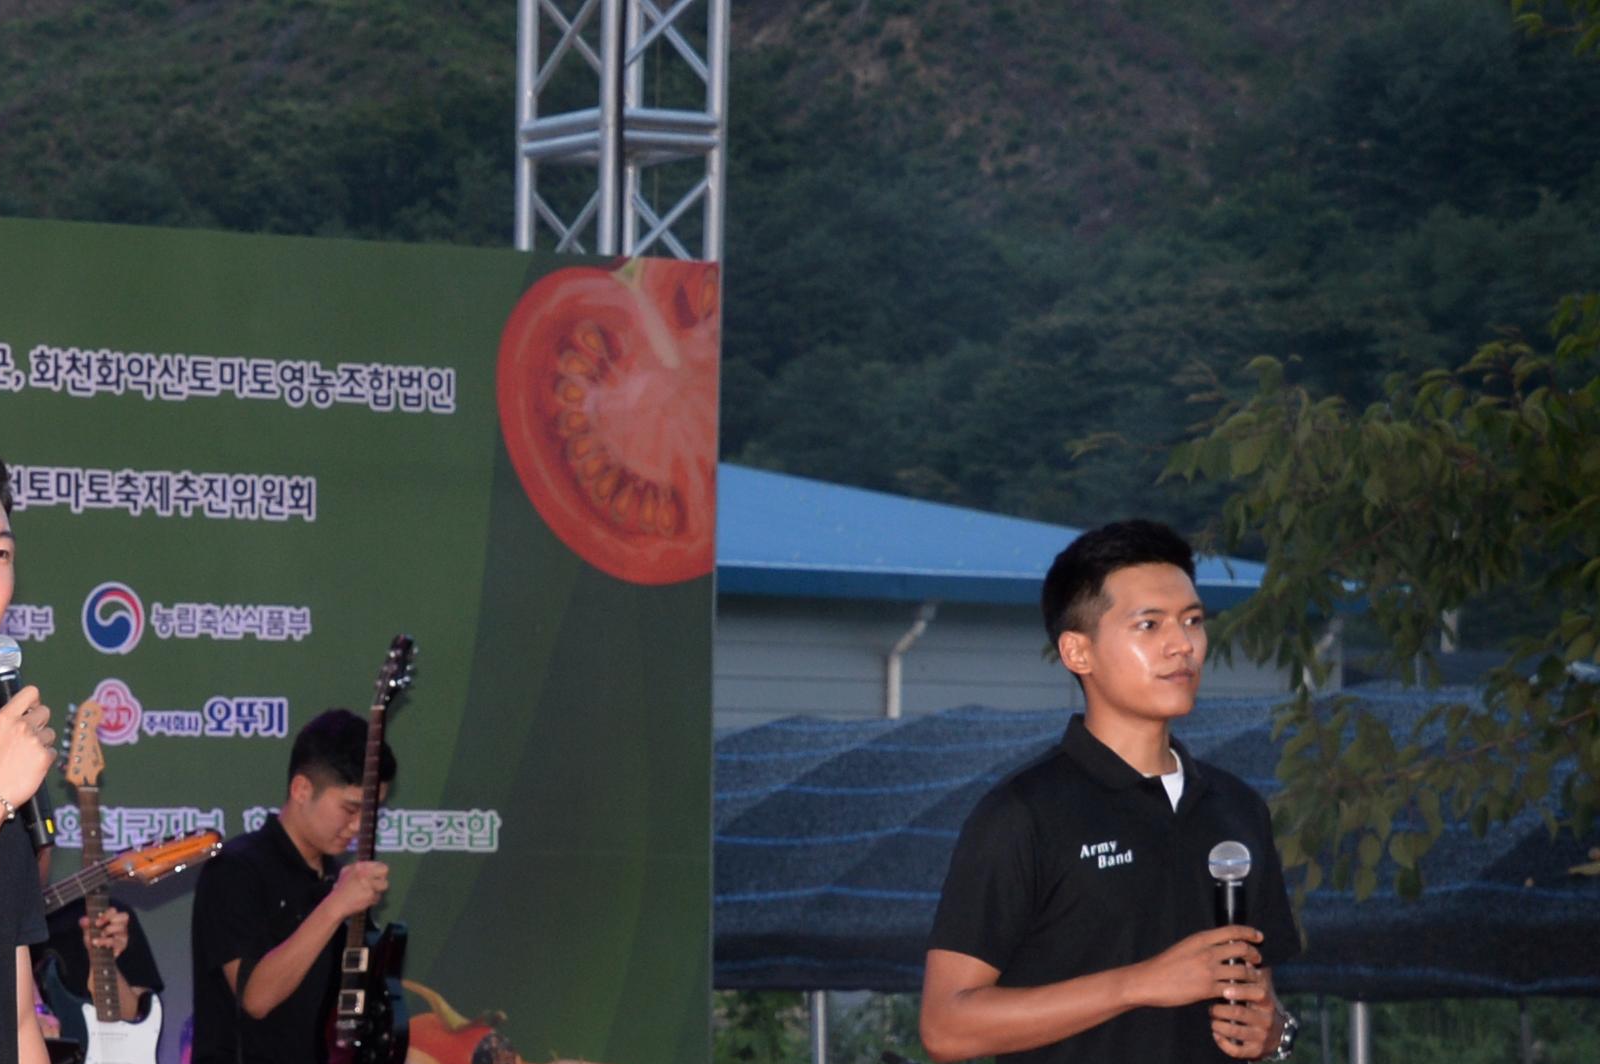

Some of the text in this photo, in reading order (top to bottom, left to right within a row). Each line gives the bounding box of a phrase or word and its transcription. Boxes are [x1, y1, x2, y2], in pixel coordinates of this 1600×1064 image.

[29, 344, 455, 413] 화천화악산토마토영농조합법인
[151, 603, 311, 641] 농림축산식품부
[204, 697, 288, 736] 오뚜기
[1080, 839, 1118, 859] Army
[1097, 850, 1133, 869] Band
